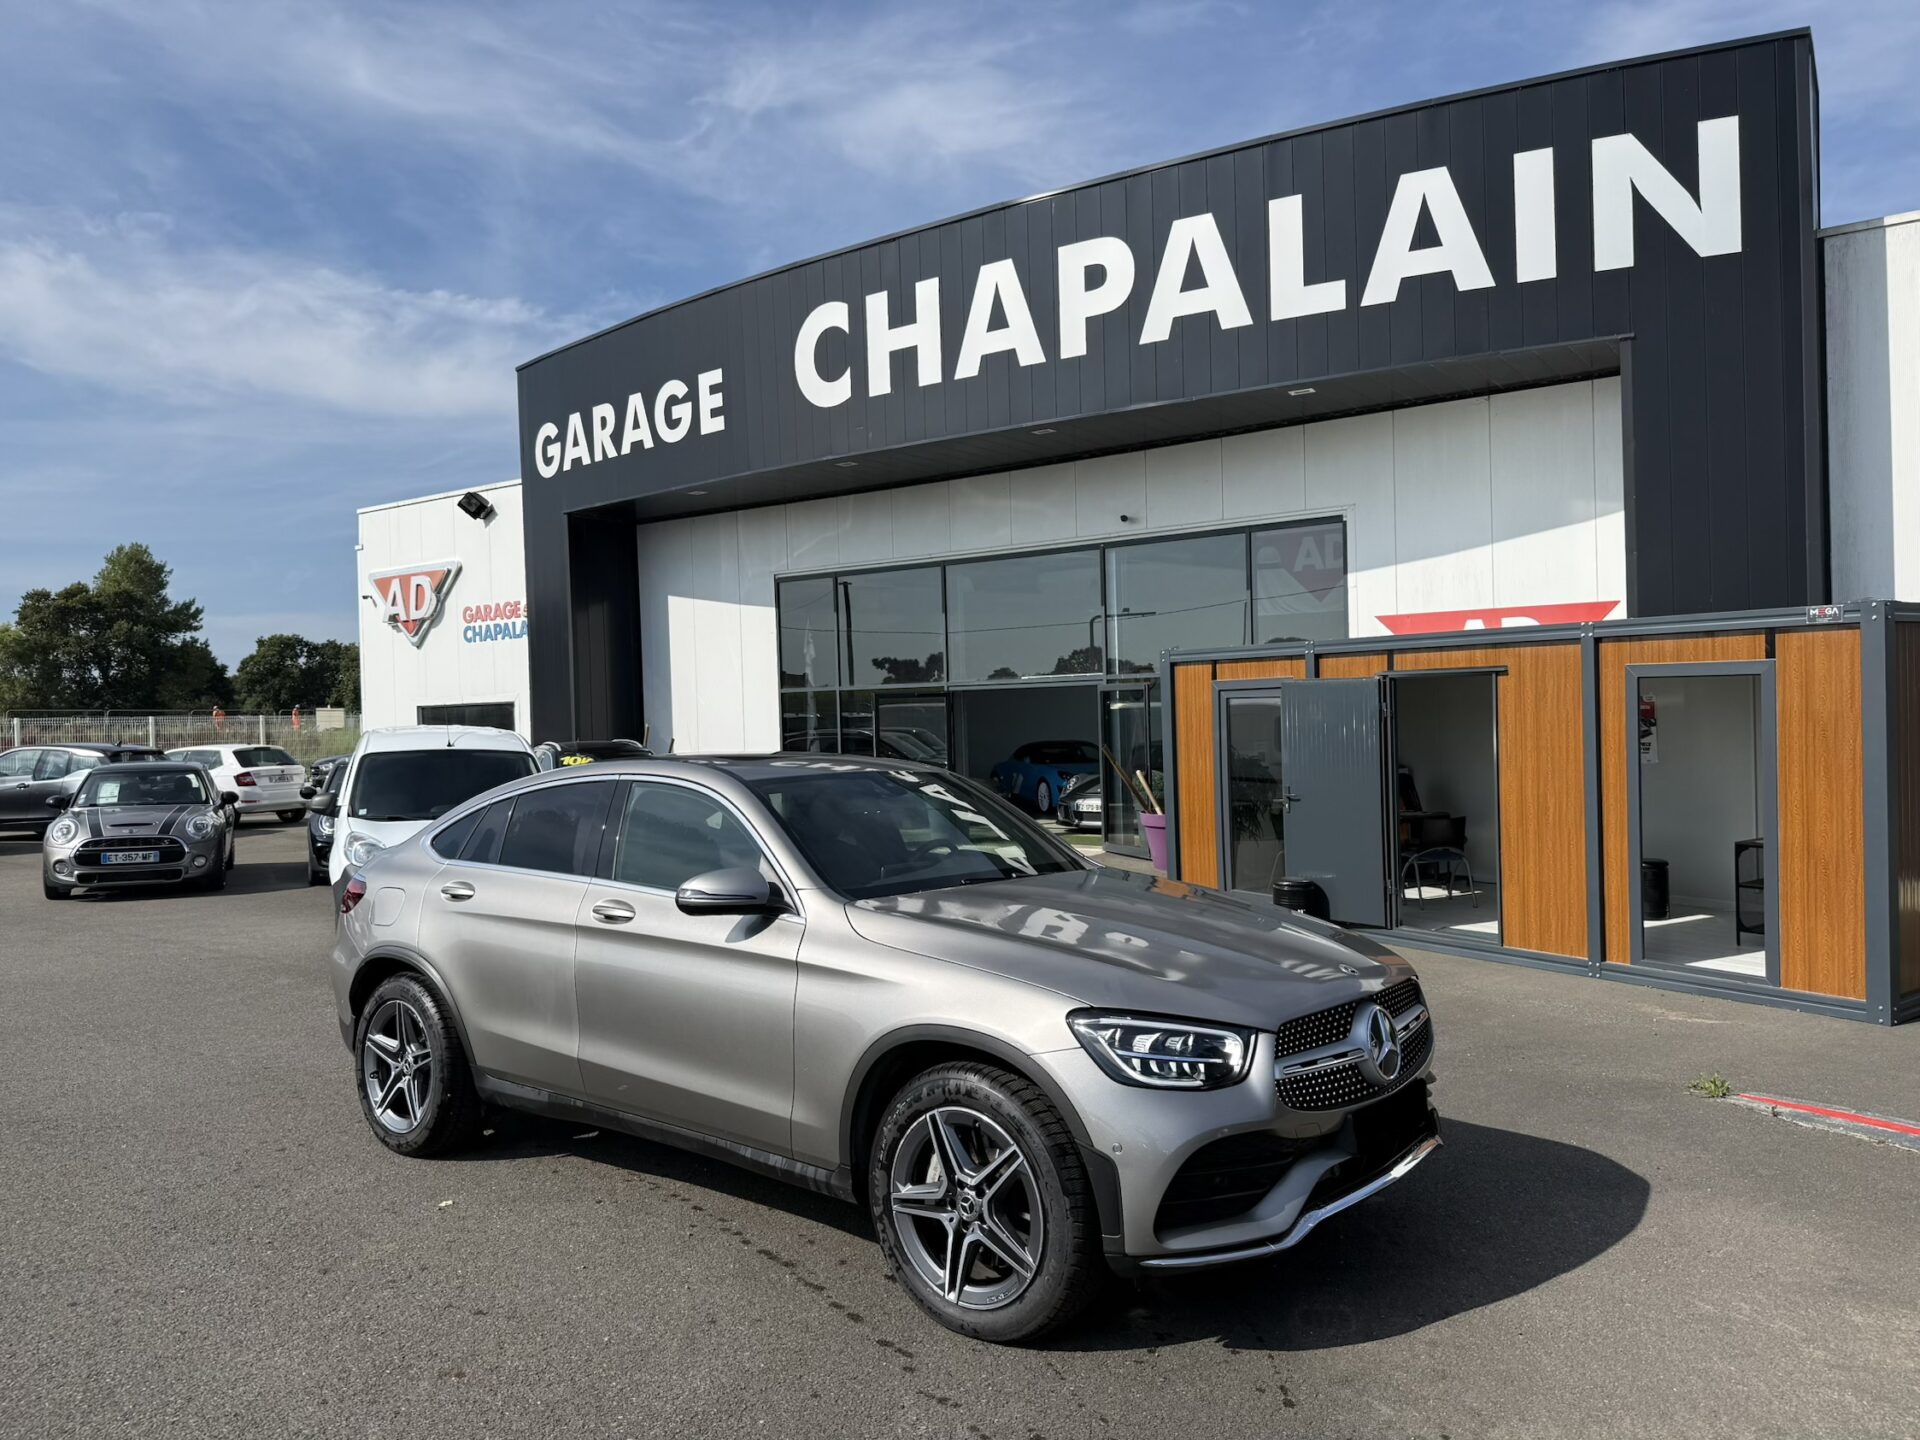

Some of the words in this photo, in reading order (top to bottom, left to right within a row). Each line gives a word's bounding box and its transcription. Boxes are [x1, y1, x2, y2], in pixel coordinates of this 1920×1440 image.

[535, 367, 725, 479] GARAGE
[794, 115, 1743, 408] CHAPALAIN
[383, 575, 436, 623] AD
[463, 601, 521, 624] GARAGE
